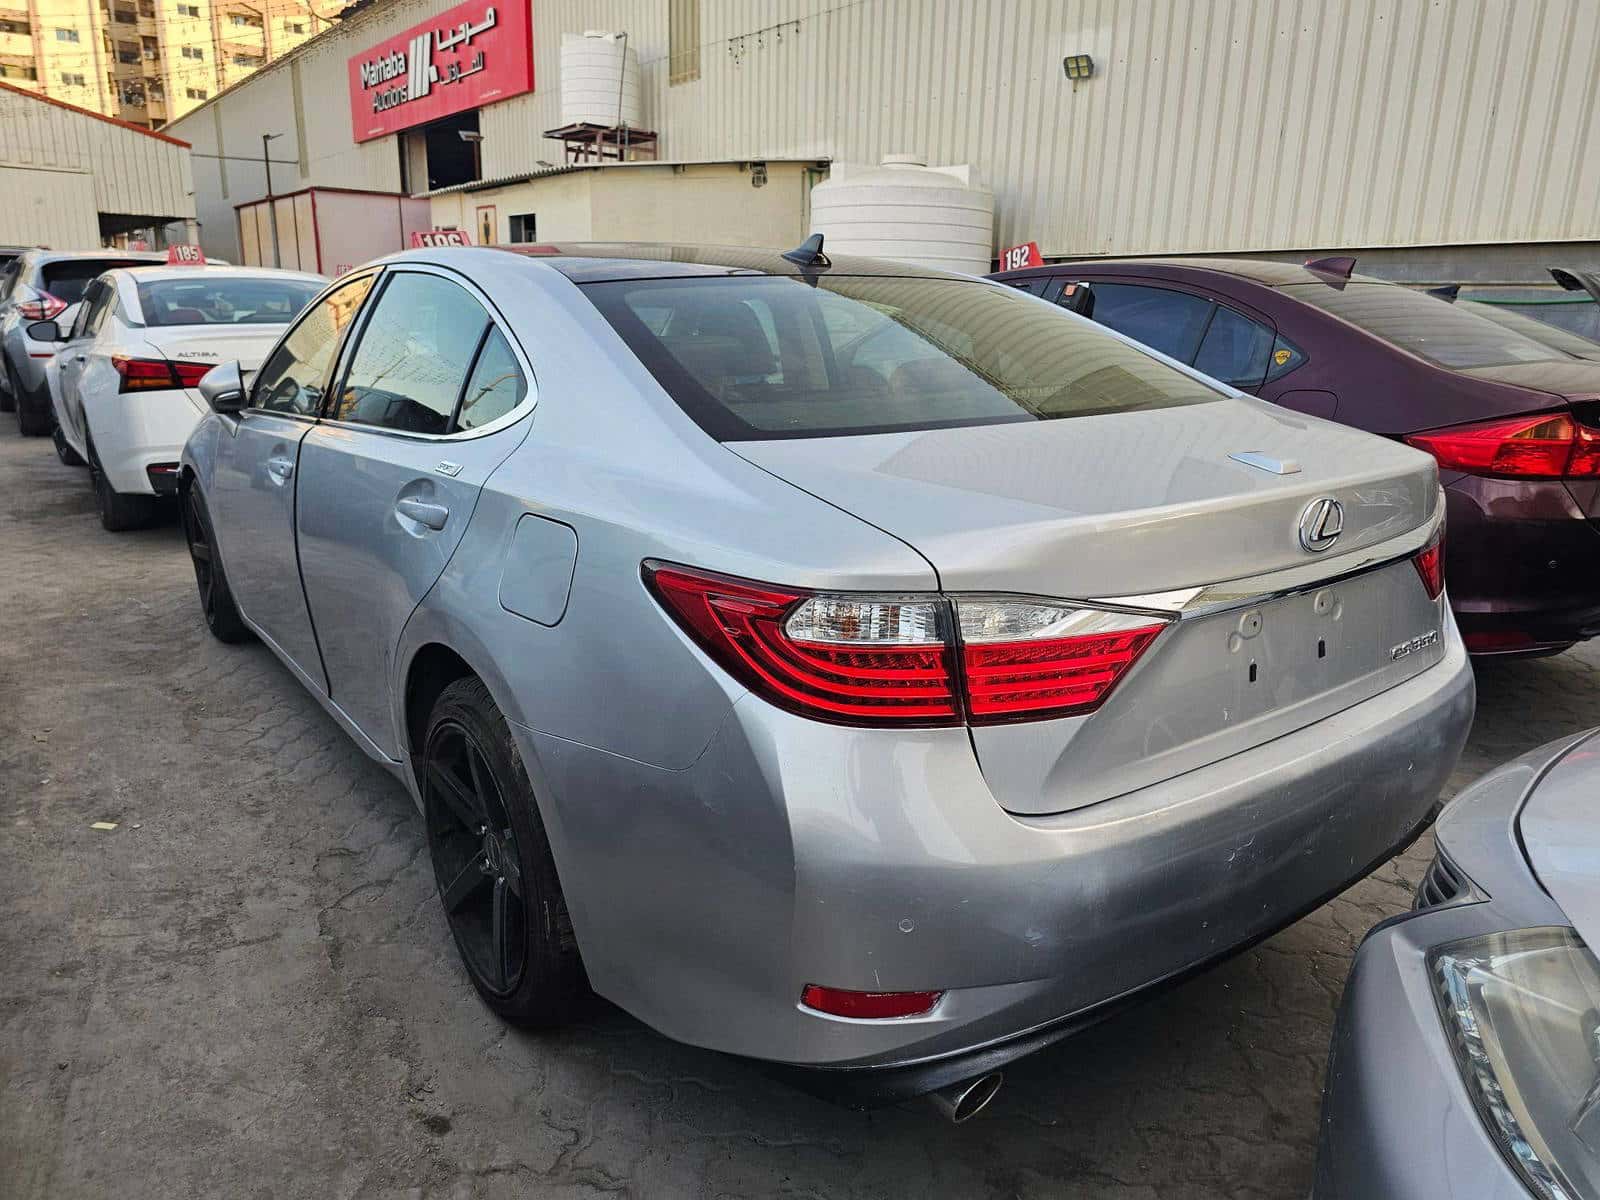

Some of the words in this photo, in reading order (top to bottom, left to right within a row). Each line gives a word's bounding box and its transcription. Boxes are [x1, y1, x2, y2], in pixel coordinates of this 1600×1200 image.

[436, 7, 496, 53] مرحبا
[360, 50, 407, 89] Marhaba
[372, 85, 408, 113] Auctions
[176, 246, 199, 261] 185
[1005, 245, 1030, 271] 192
